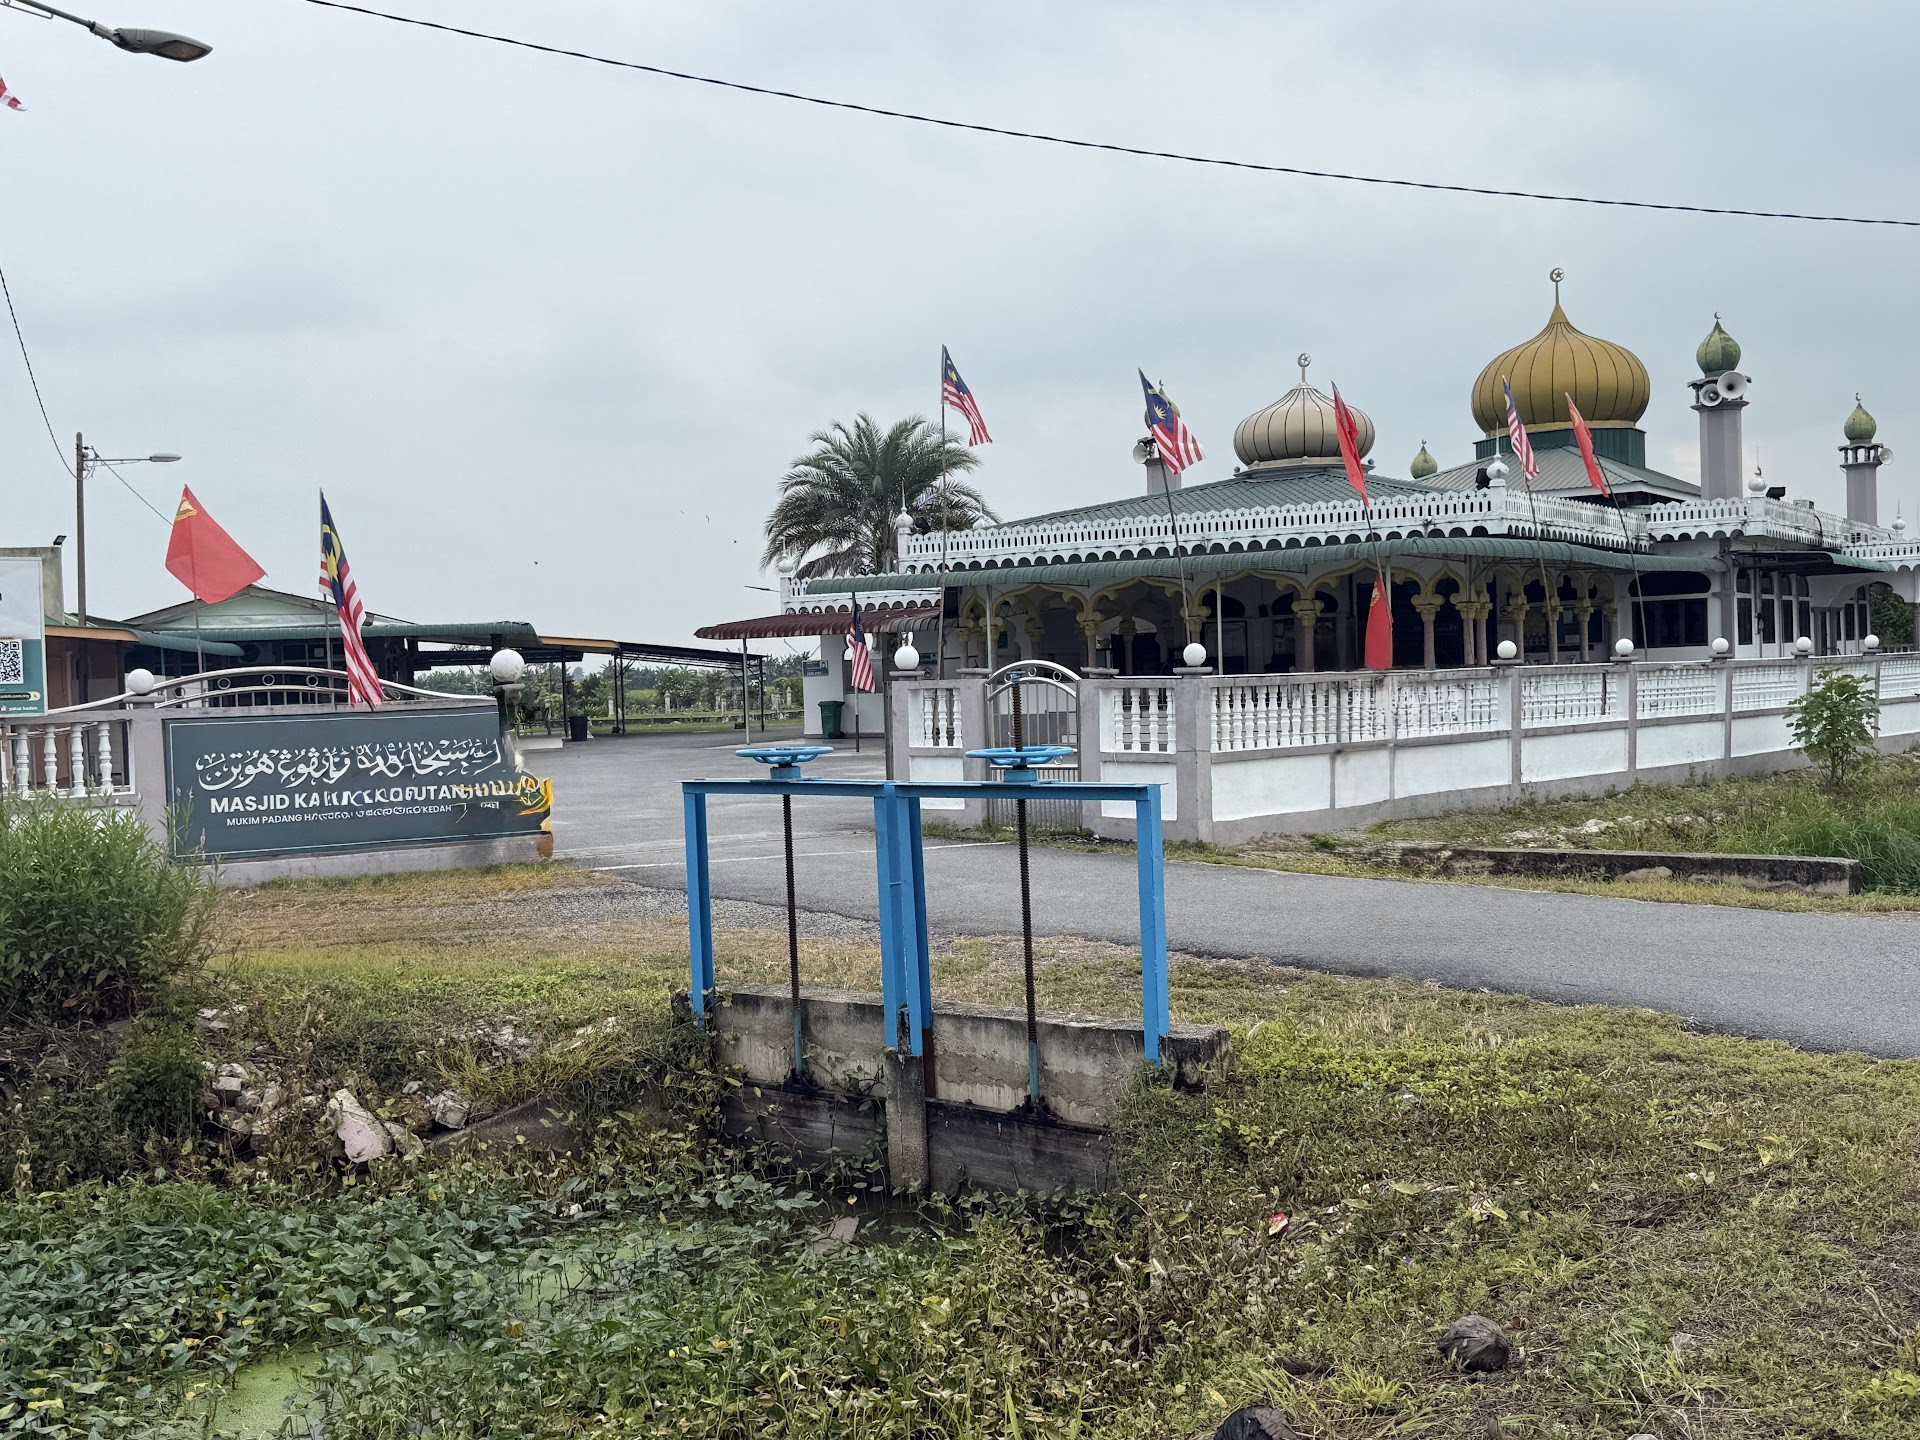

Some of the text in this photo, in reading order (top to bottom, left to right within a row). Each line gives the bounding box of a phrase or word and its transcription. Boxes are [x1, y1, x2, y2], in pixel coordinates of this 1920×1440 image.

[210, 793, 290, 813] MASJID
[226, 816, 260, 826] MUKIM
[262, 814, 302, 824] PADANG
[422, 805, 452, 814] KEDAH
